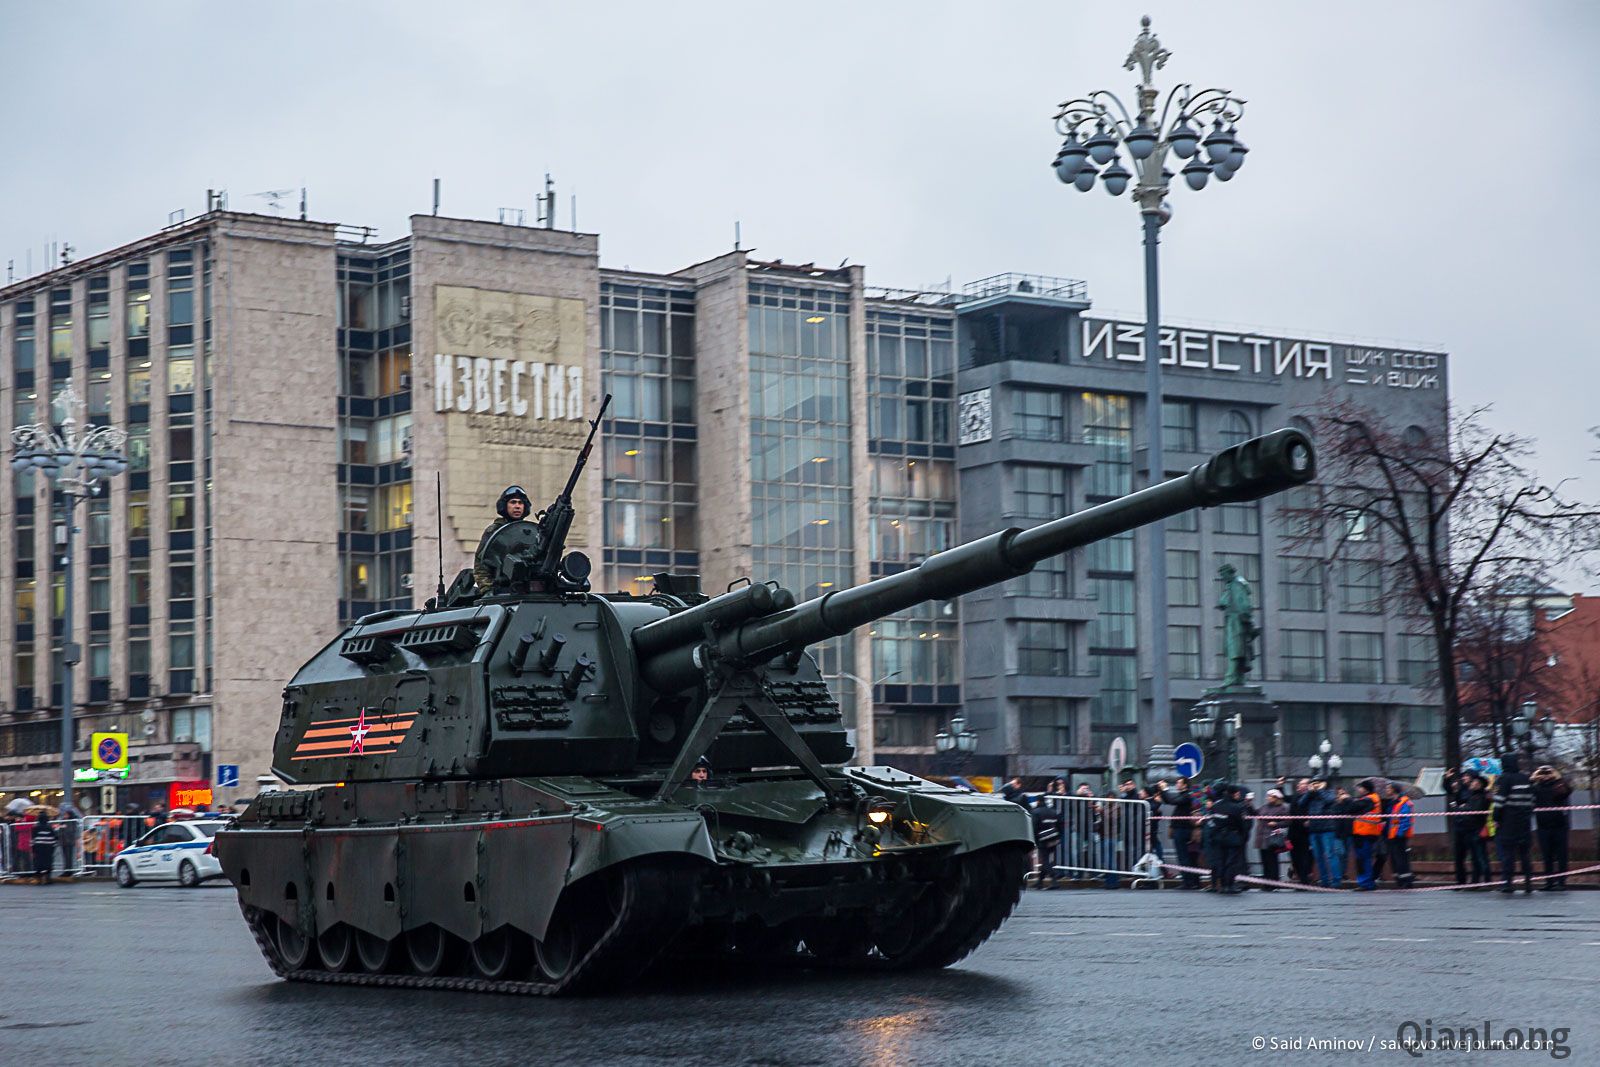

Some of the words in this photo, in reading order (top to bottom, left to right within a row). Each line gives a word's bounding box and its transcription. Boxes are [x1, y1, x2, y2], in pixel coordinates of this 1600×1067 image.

[1082, 319, 1333, 380] ИЗВЕСТИЯ
[1391, 352, 1439, 370] СССР
[434, 353, 584, 421] ИЗВЕСТИЯ
